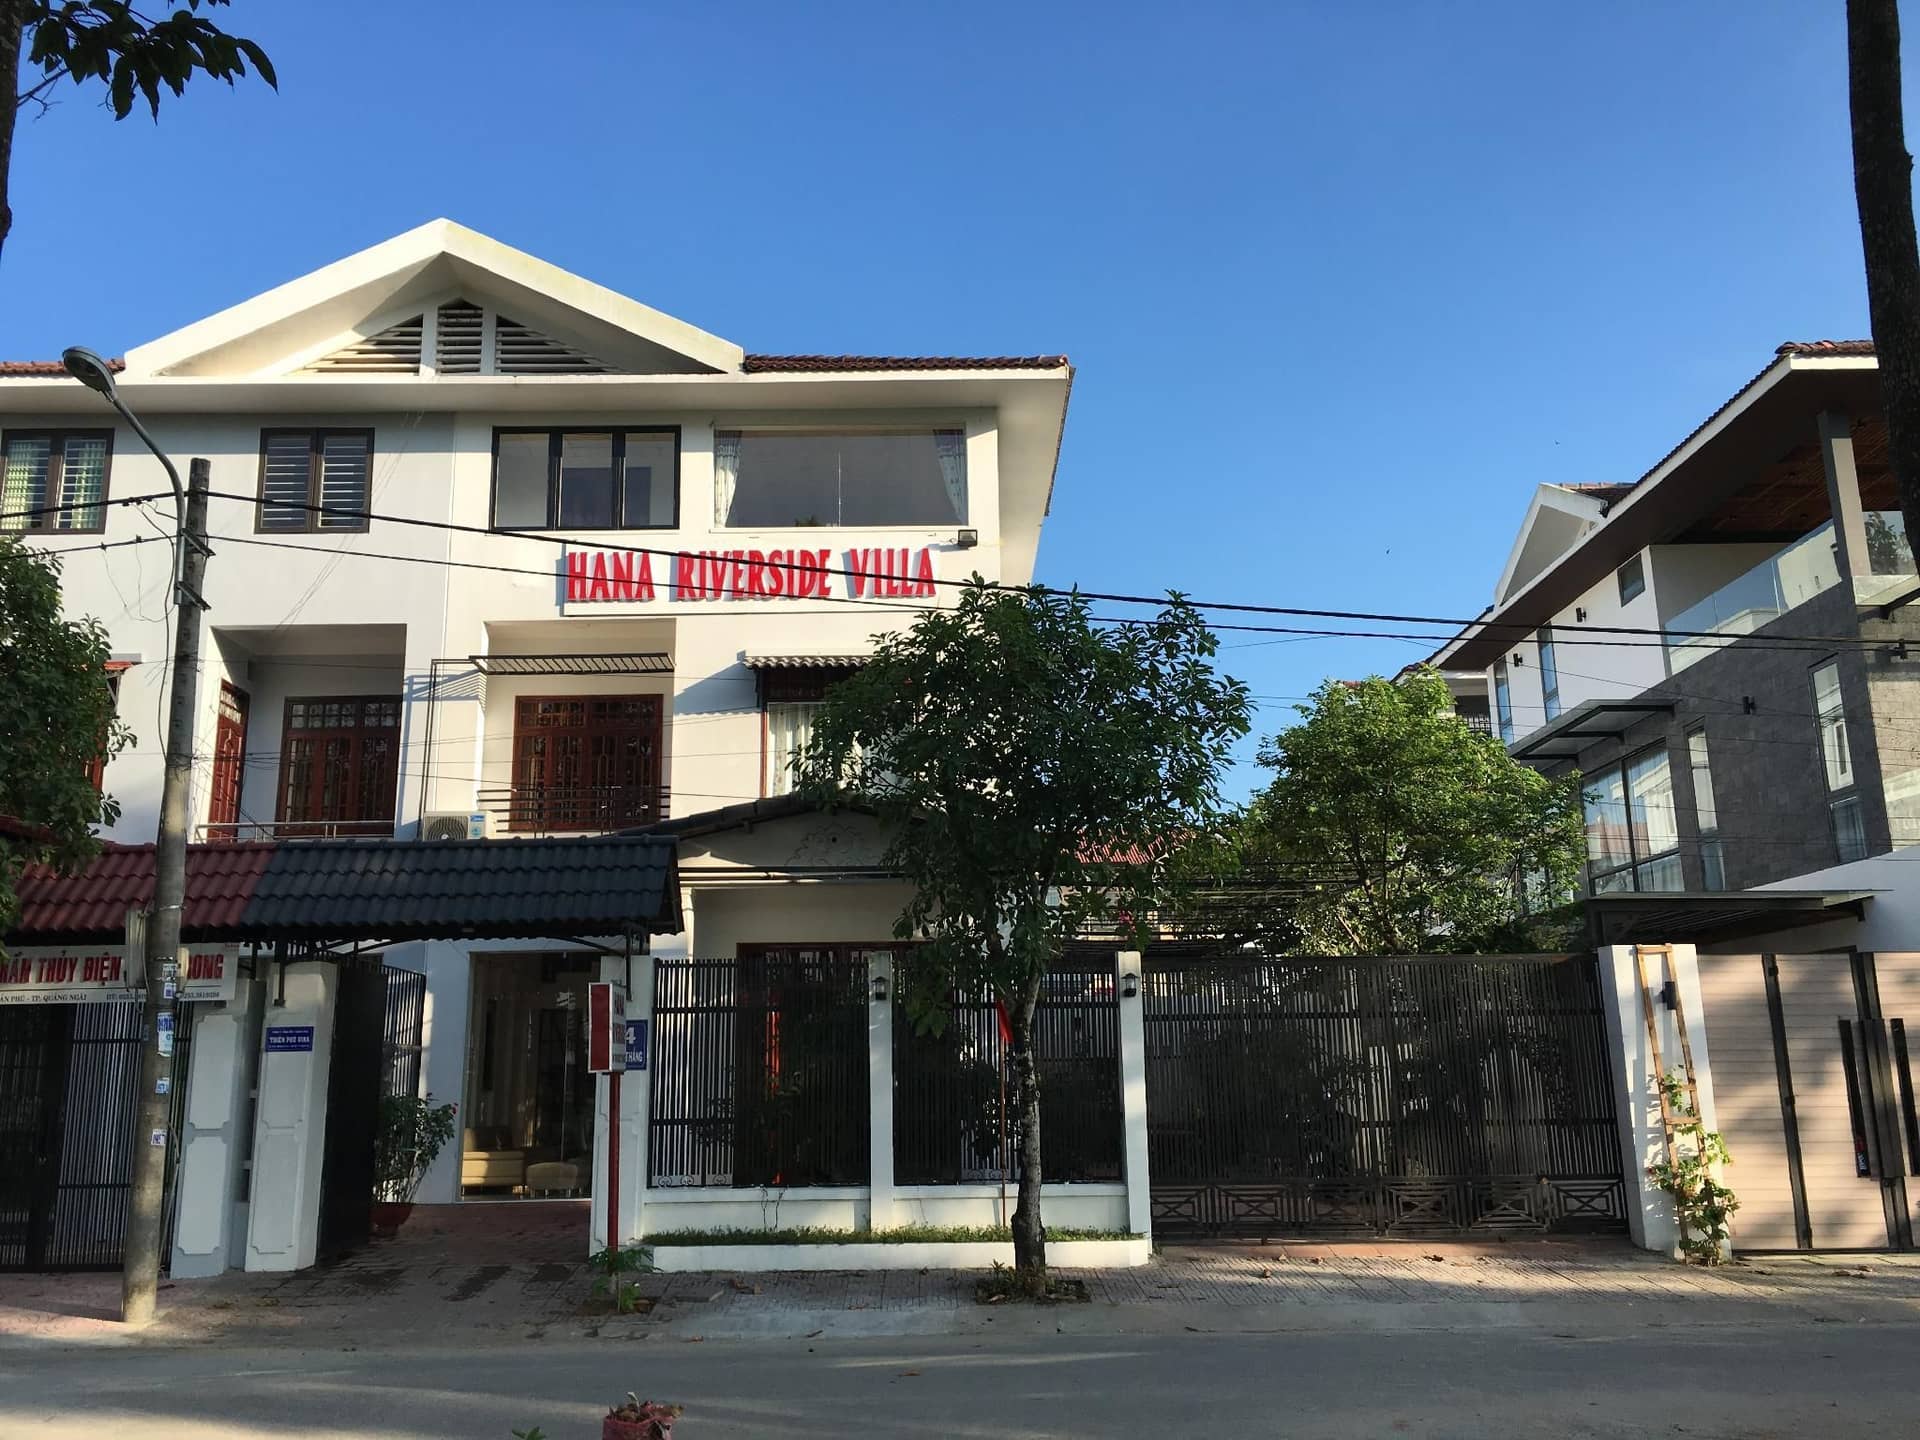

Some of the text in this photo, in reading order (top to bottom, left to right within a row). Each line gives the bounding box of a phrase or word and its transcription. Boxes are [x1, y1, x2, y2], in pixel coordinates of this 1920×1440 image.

[567, 547, 937, 601] HANA RIVERSIDE VILLA
